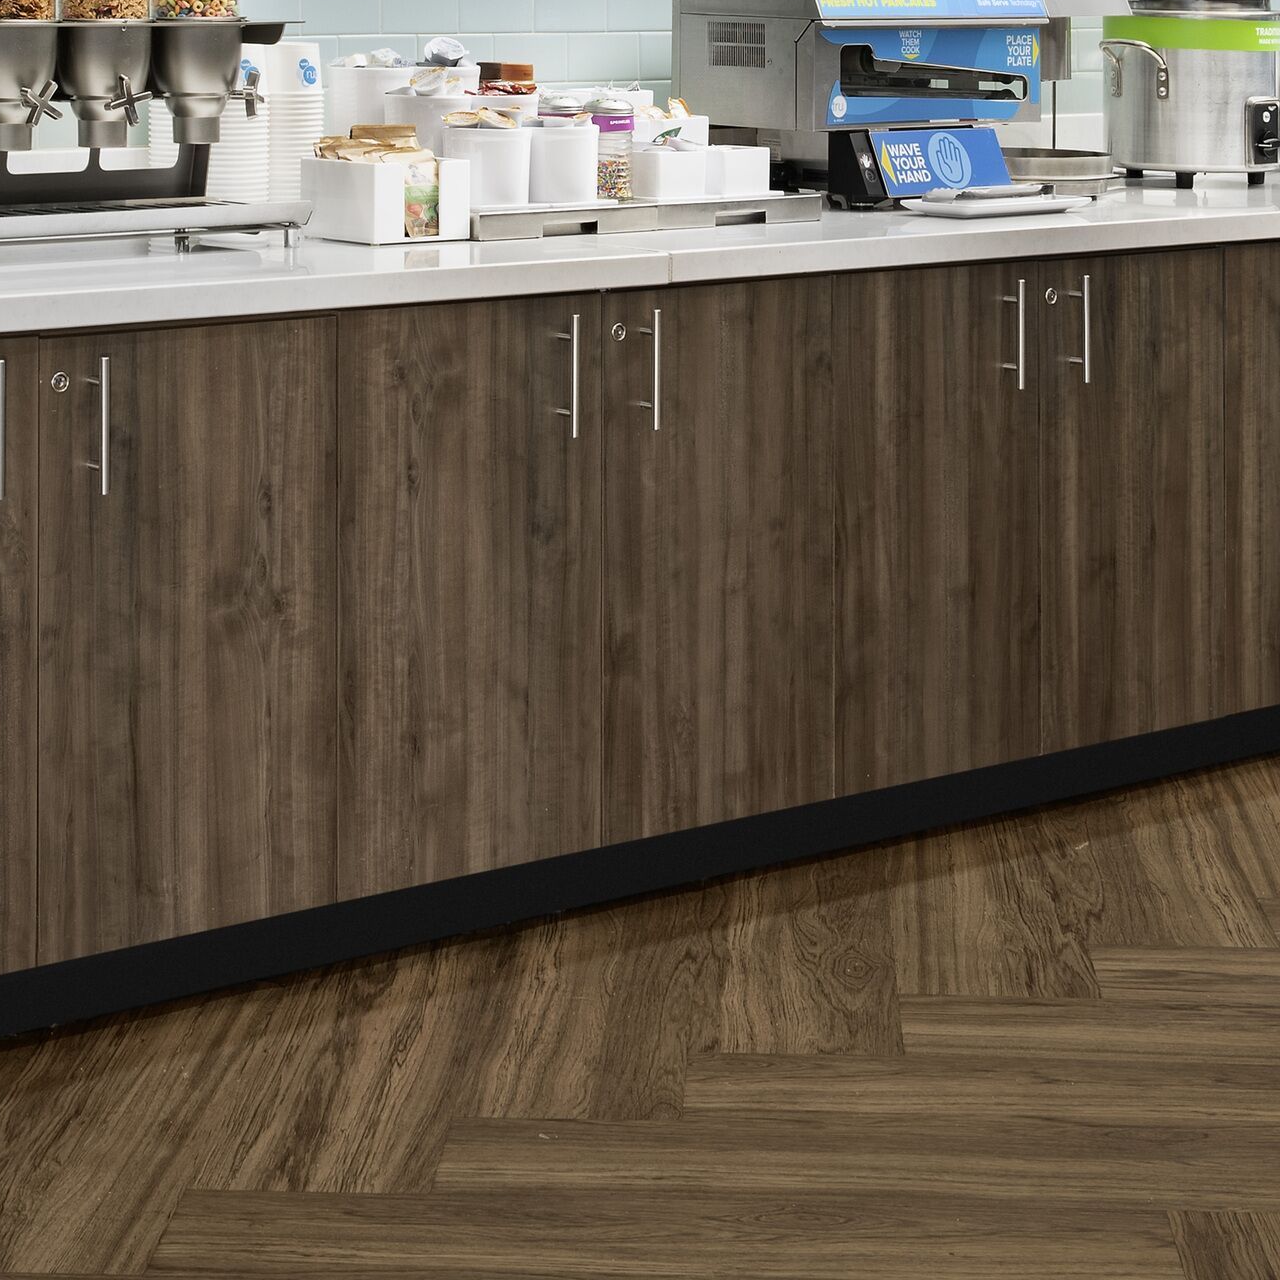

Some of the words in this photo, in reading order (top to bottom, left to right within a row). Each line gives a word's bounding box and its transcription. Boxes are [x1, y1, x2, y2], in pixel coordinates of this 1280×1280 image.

[898, 30, 922, 38] WATCH
[1006, 34, 1032, 45] PLACE
[901, 38, 920, 46] THEM
[900, 46, 920, 54] COOK
[1007, 46, 1031, 56] YOUR
[1006, 56, 1032, 67] PLATE
[886, 143, 922, 156] WAVE
[892, 156, 926, 170] YOUR
[898, 170, 932, 184] HAND
